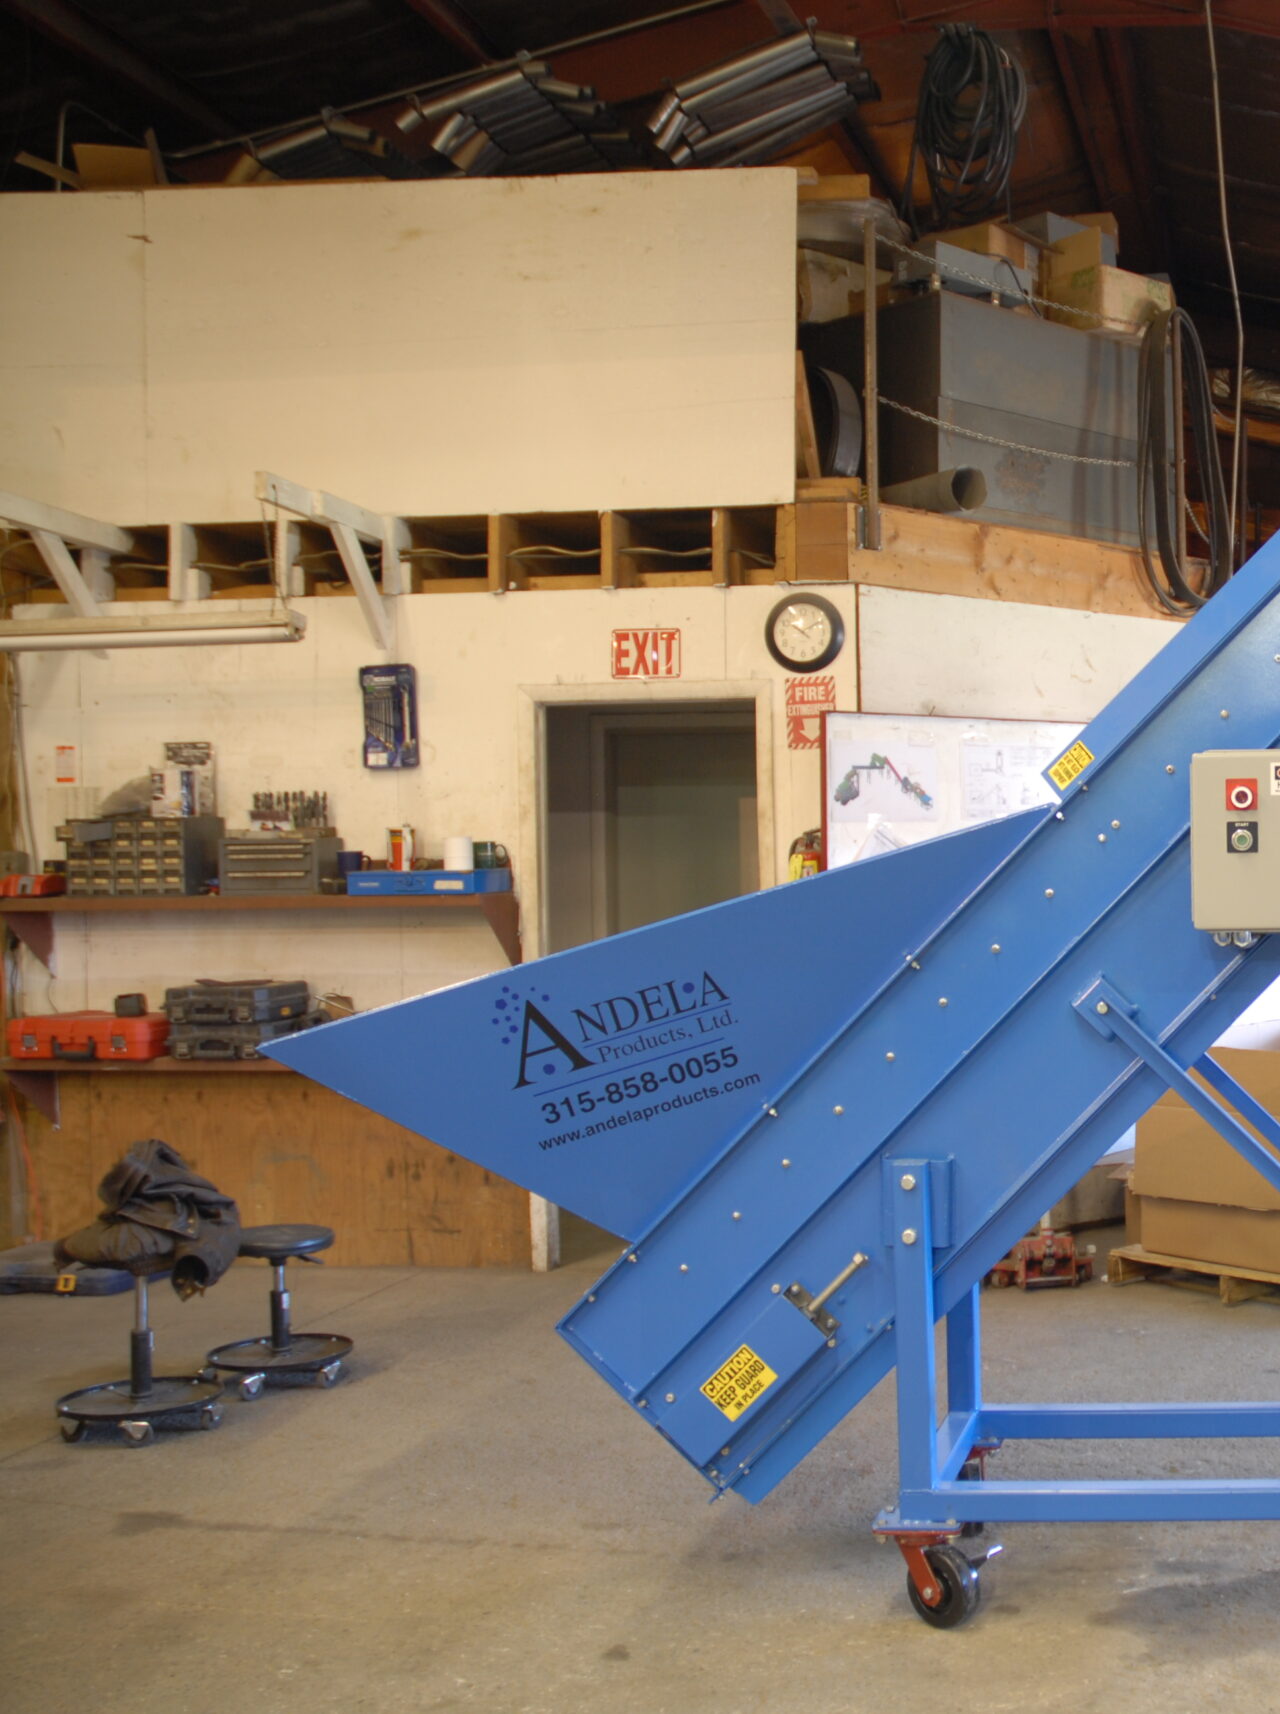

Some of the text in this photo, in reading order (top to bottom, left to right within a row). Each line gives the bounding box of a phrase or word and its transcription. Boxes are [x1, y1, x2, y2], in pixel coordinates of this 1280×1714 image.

[615, 631, 677, 676] EXIT
[795, 686, 826, 702] FIRE
[596, 1009, 739, 1063] Products, Ltd.
[541, 1045, 739, 1125] 315-858-0055
[538, 1072, 761, 1151] www.andelaproducts.com
[703, 1348, 754, 1397] CAUTION
[715, 1359, 766, 1410] KEEP GUARD
[734, 1380, 764, 1410] IN PLACE
